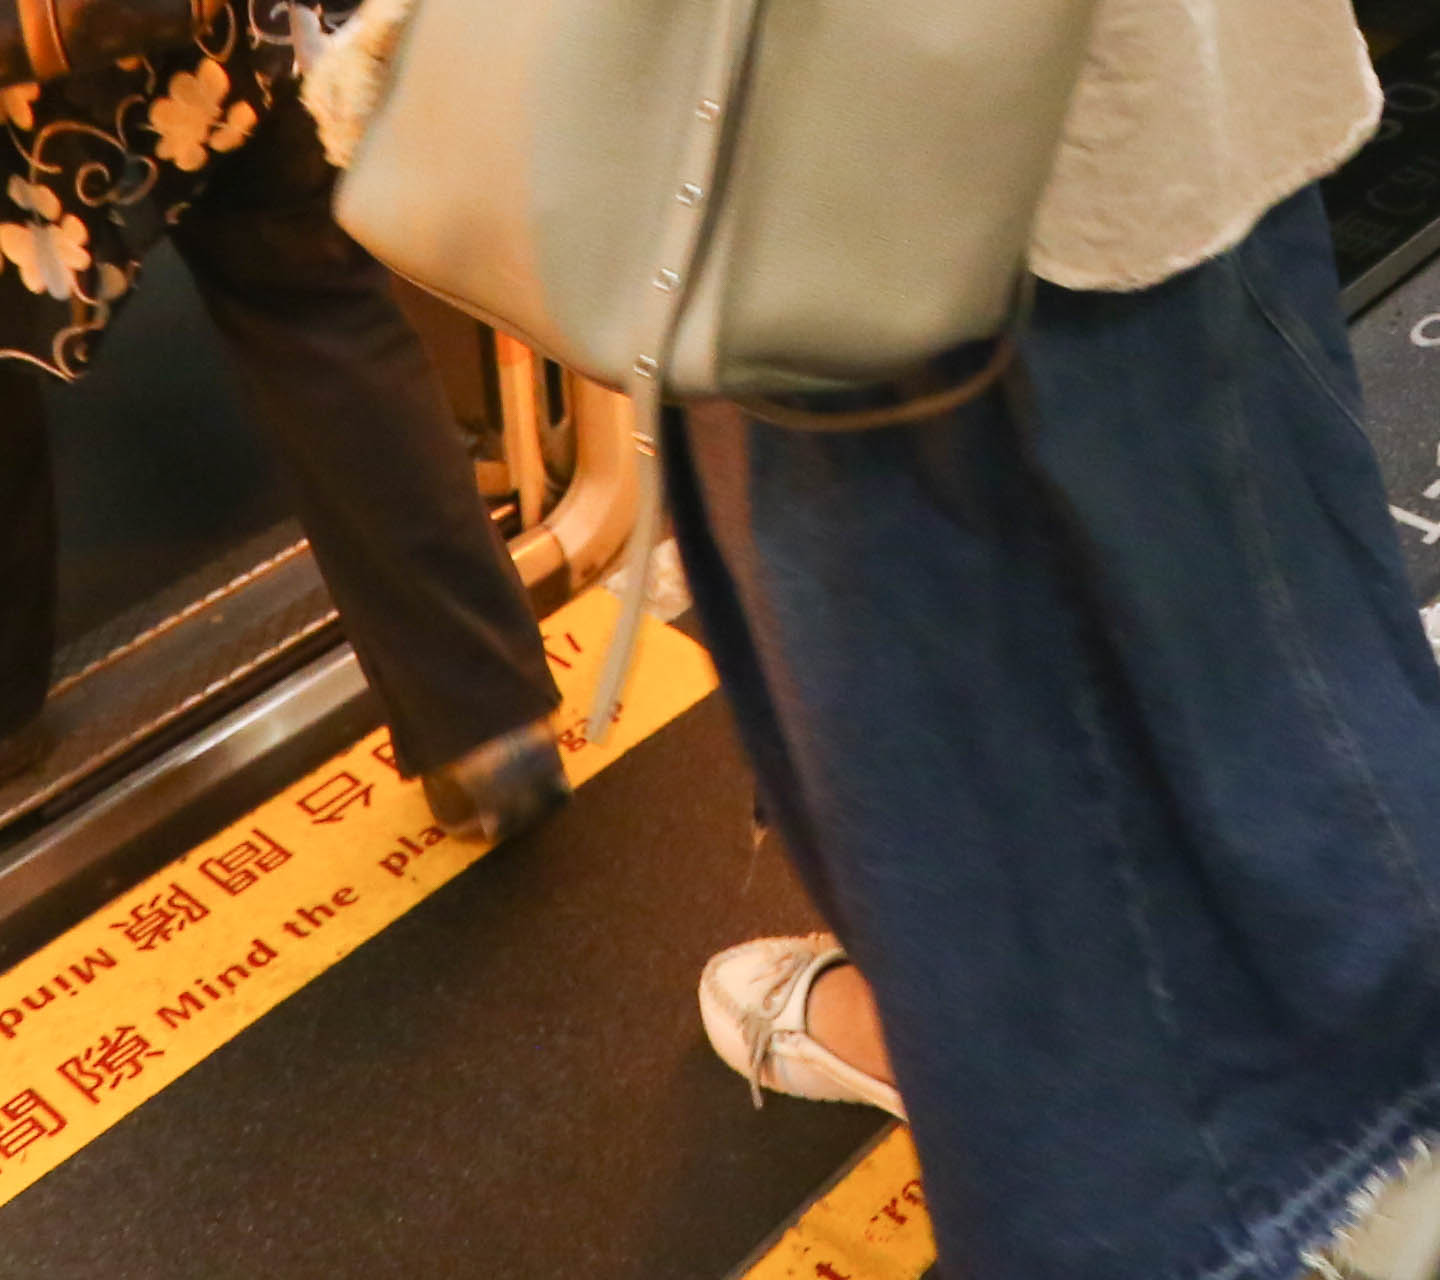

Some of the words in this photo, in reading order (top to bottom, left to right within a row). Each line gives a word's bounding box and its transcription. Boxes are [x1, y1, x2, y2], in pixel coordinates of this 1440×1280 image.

[108, 741, 399, 951] 台間隙
[155, 938, 280, 1030] Mind
[281, 885, 362, 939] the
